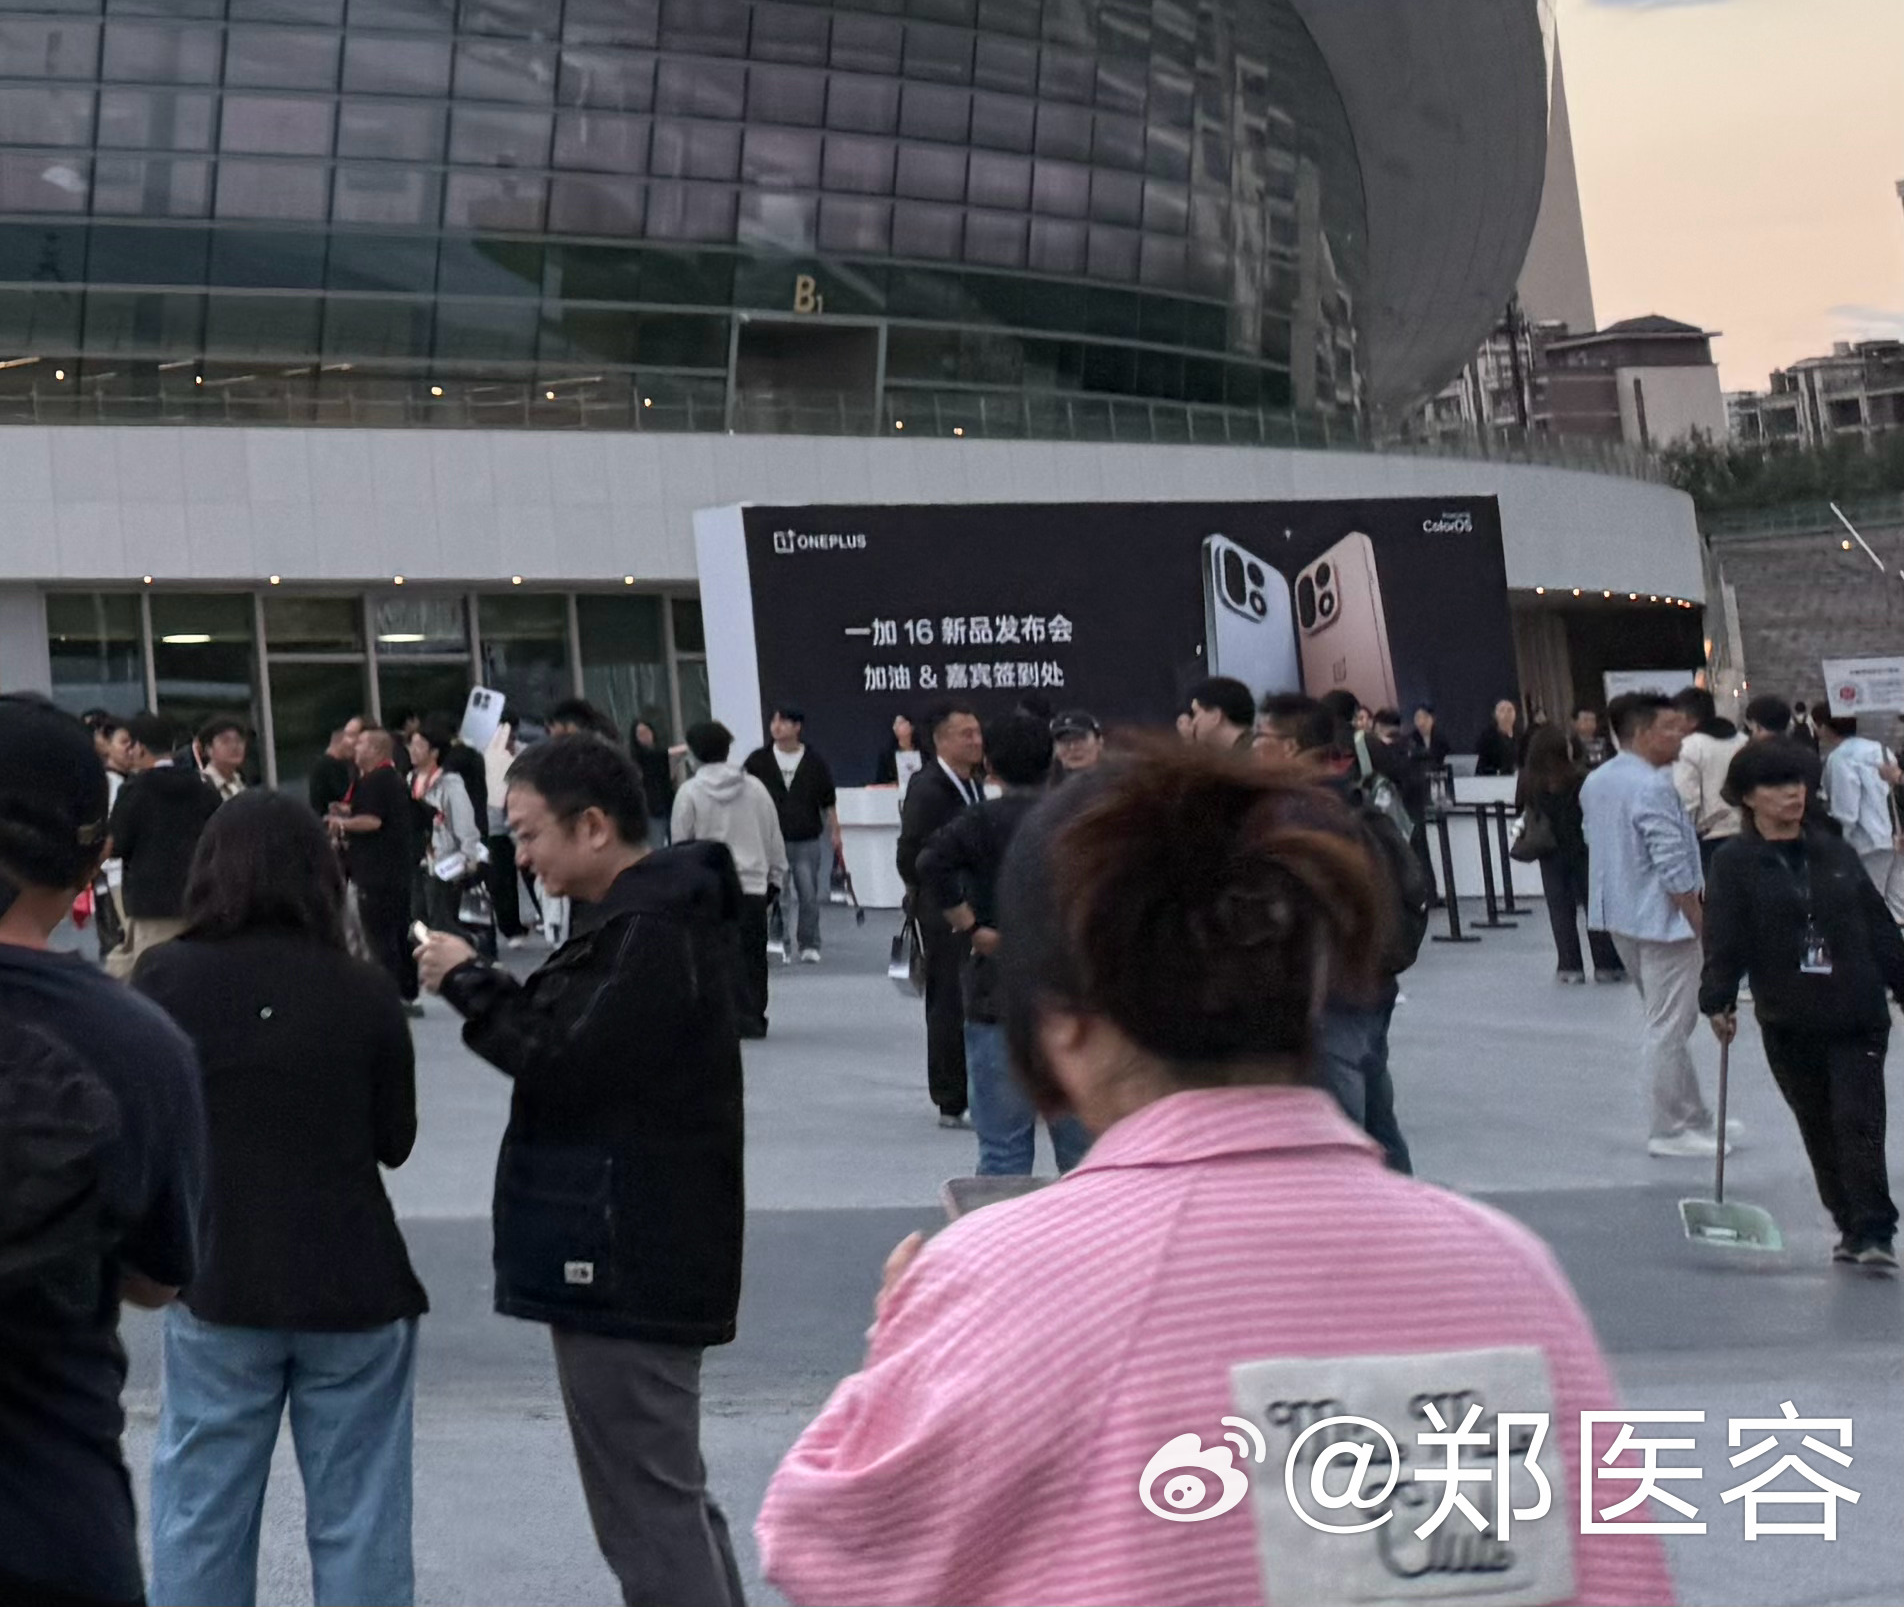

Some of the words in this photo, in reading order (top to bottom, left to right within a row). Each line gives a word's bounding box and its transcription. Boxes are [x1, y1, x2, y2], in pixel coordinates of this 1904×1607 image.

[844, 617, 898, 646] 一加
[904, 618, 934, 645] 16
[941, 613, 1073, 645] 新品发布会
[864, 663, 911, 691] 加油
[919, 664, 938, 690] &
